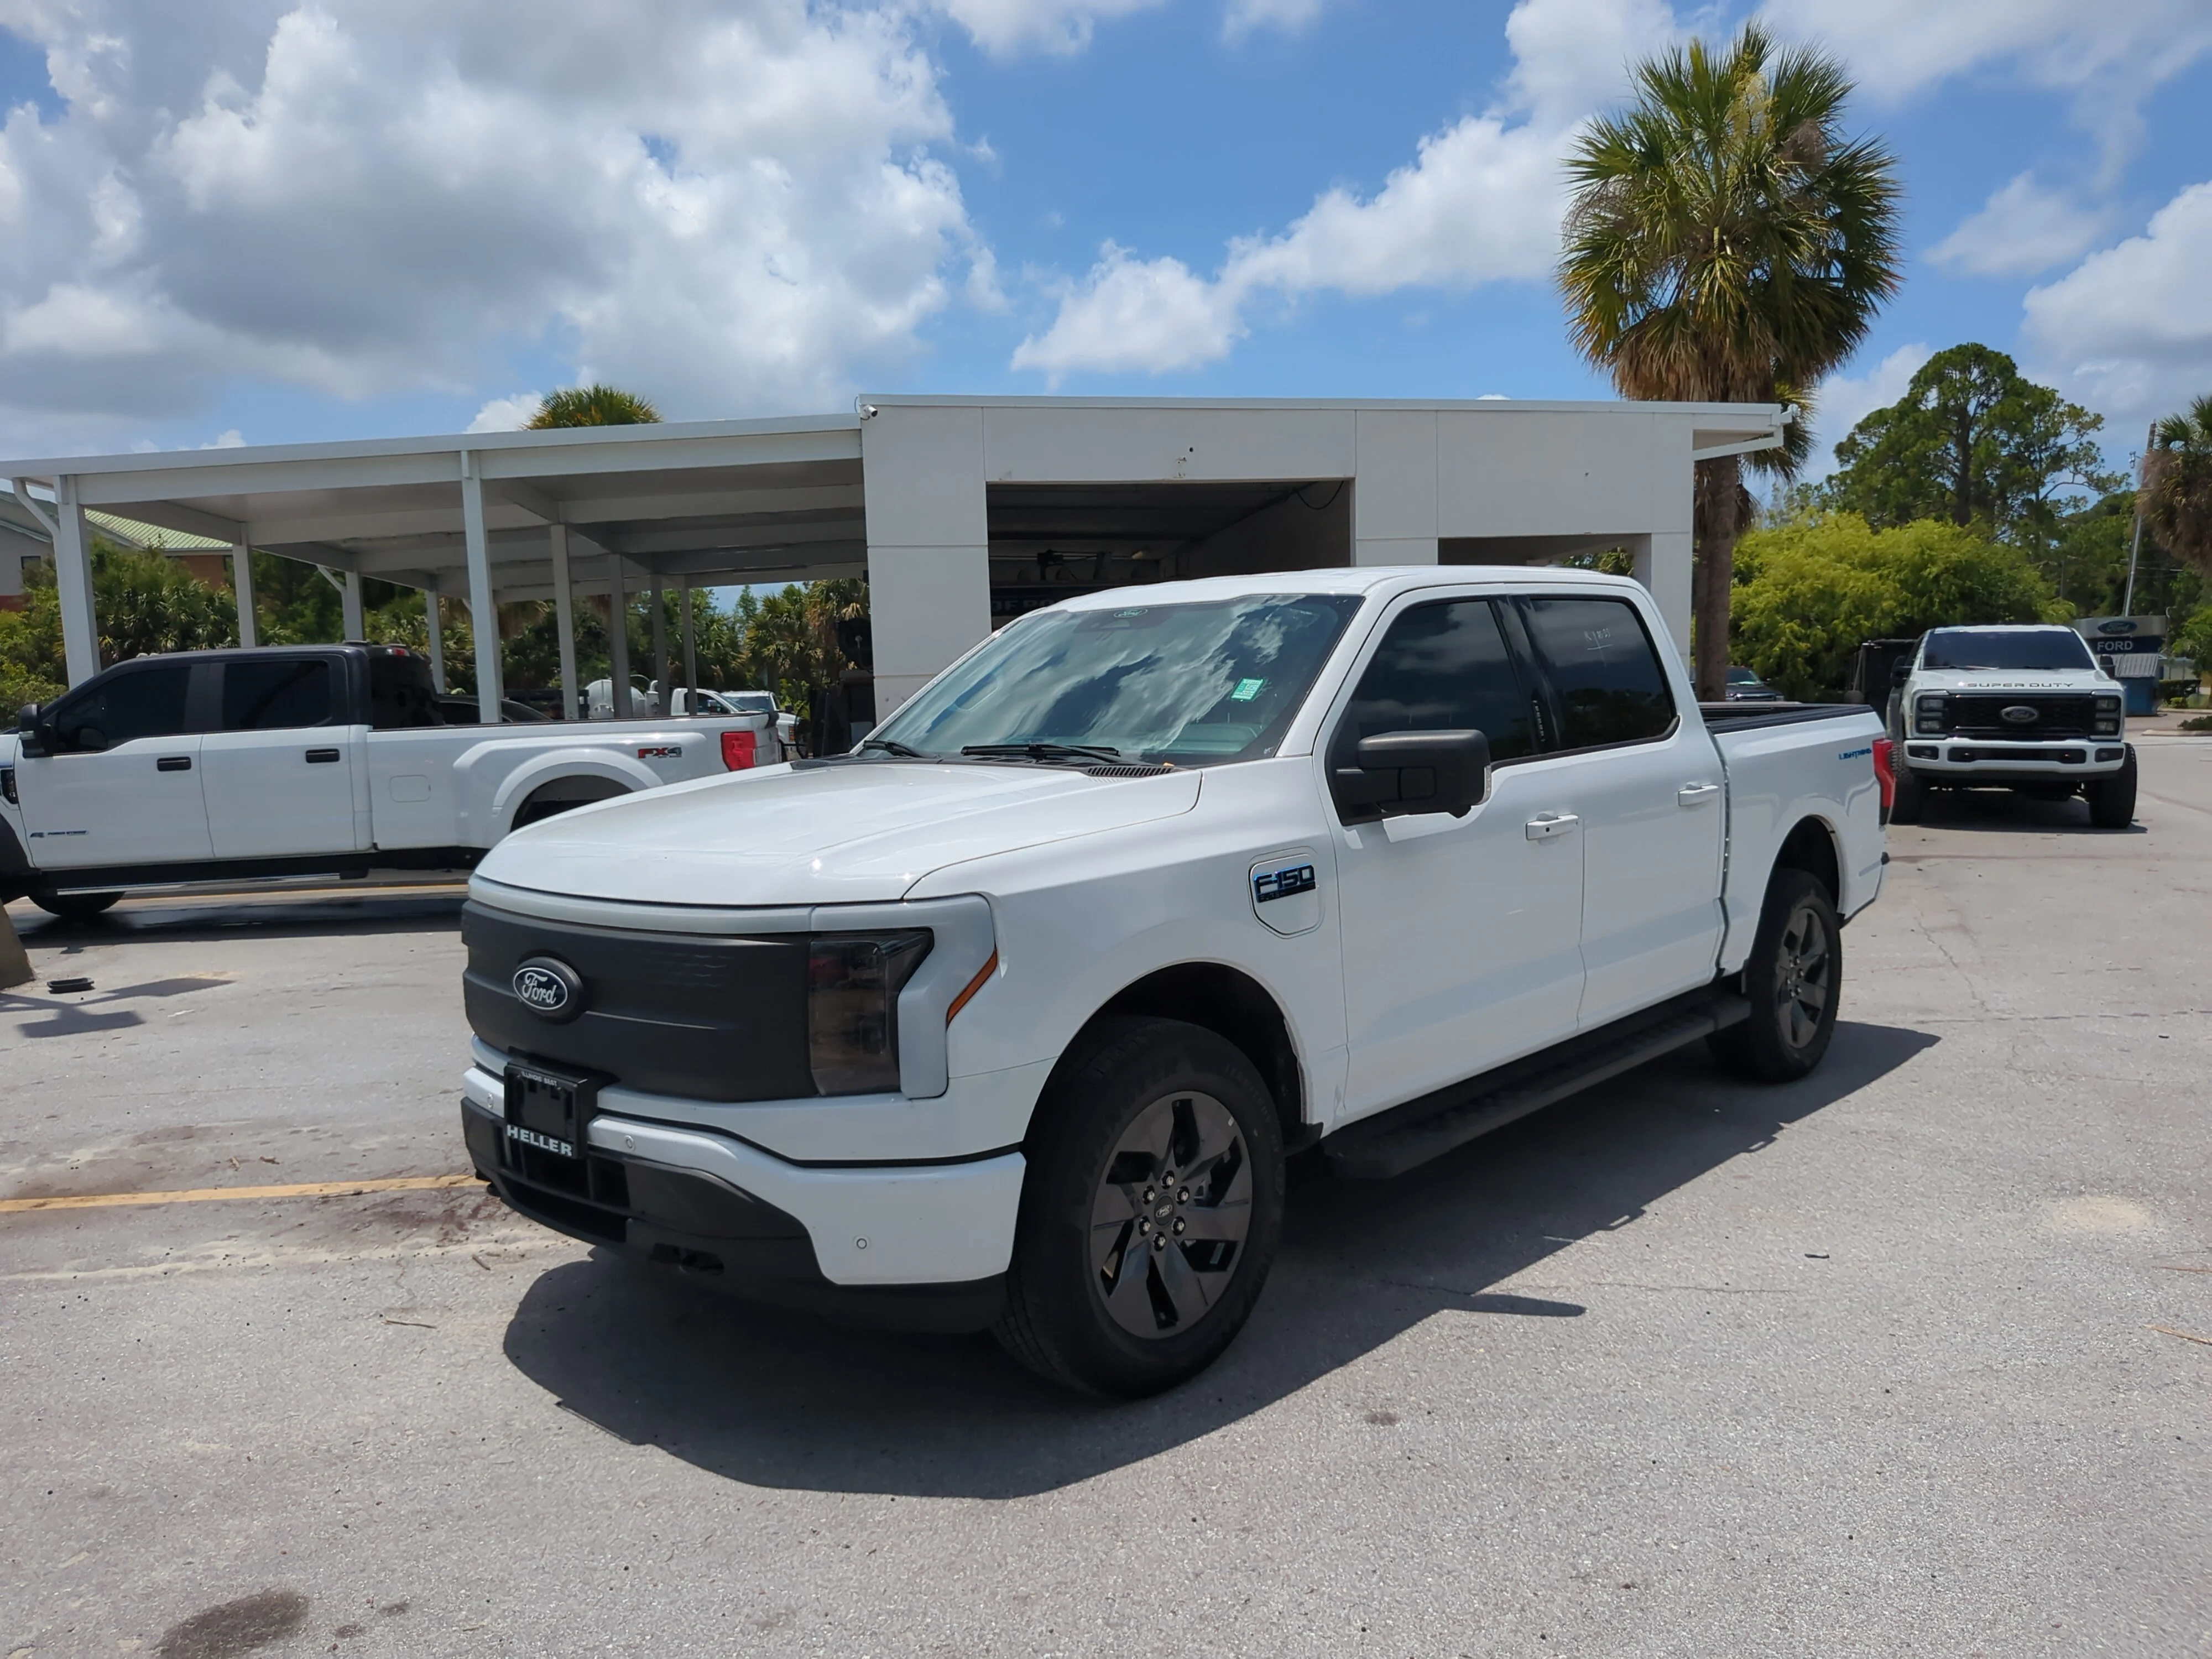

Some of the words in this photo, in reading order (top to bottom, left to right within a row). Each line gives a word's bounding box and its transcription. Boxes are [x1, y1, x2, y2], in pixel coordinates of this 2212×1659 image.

[2097, 641, 2133, 651] FORD
[638, 747, 682, 759] FX4
[1253, 863, 1315, 894] F-150
[522, 972, 557, 1004] Ford
[507, 1124, 572, 1157] HELLER
